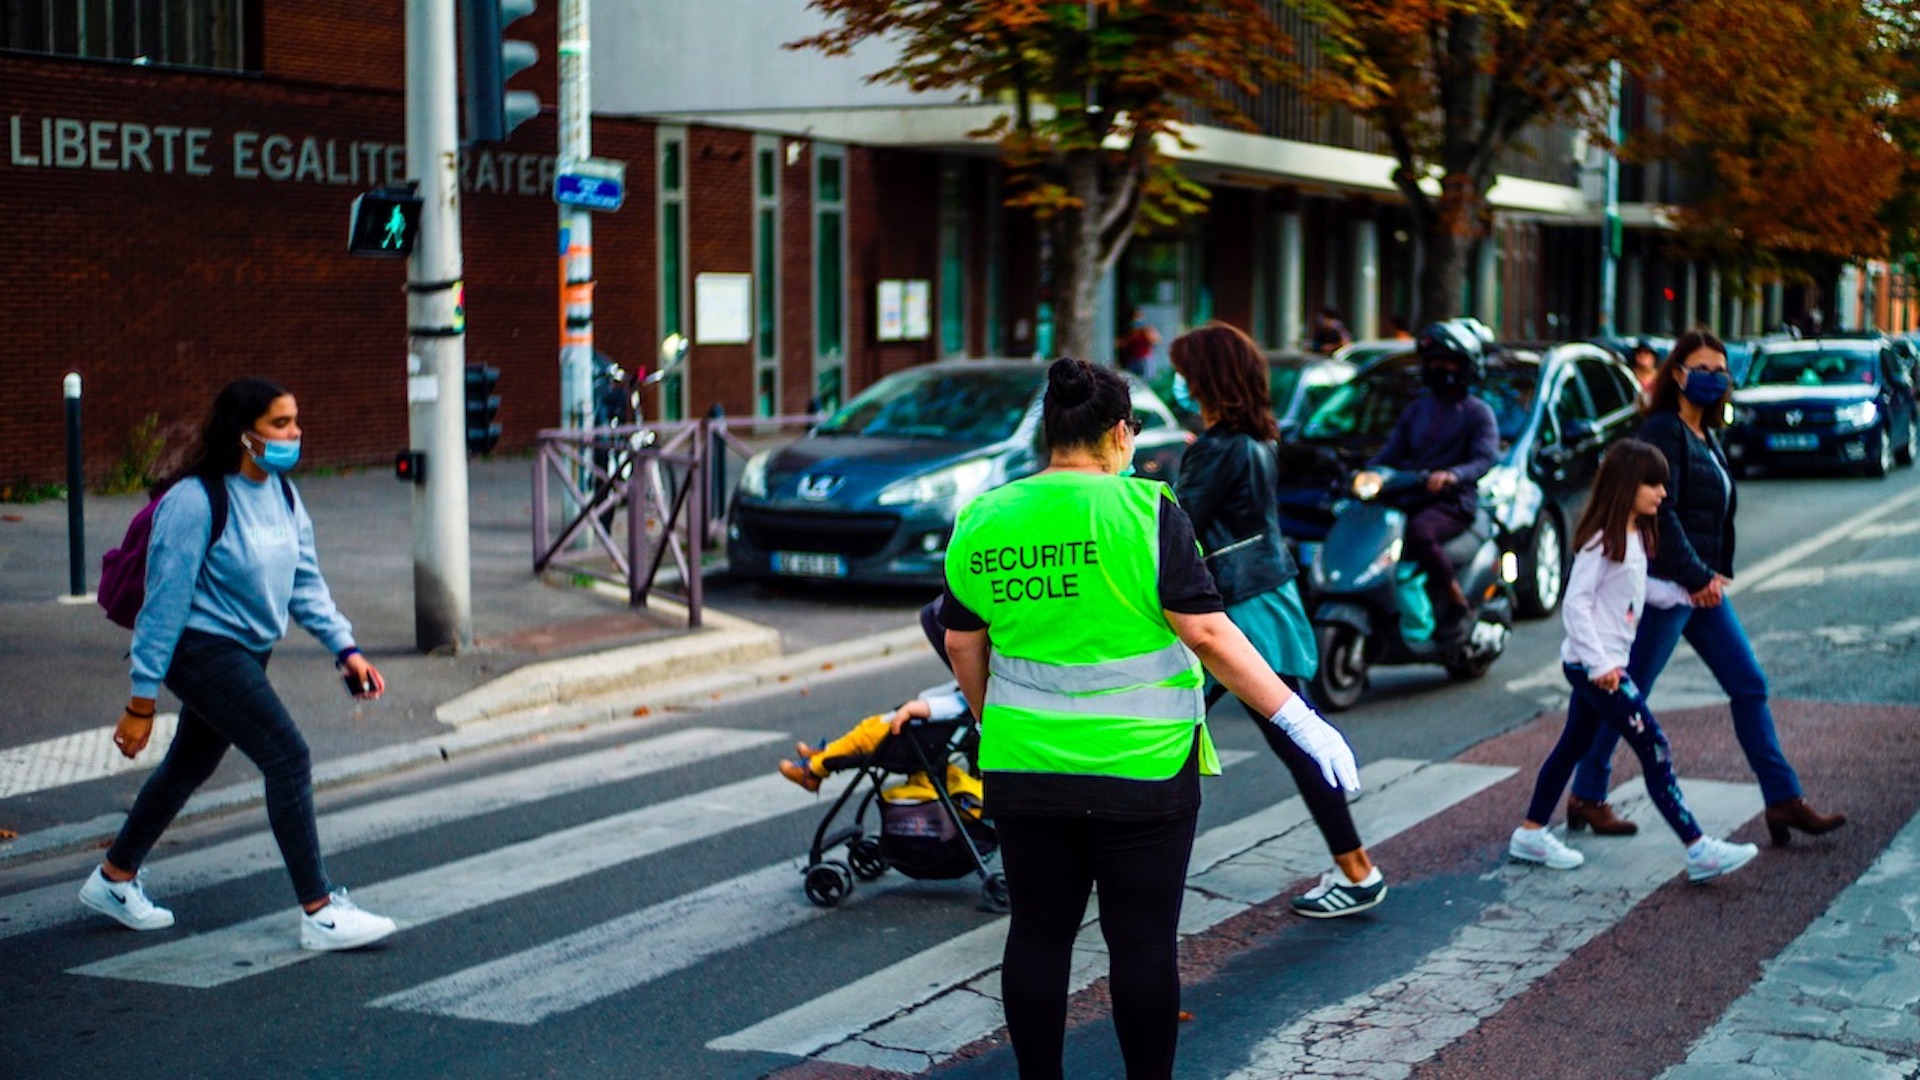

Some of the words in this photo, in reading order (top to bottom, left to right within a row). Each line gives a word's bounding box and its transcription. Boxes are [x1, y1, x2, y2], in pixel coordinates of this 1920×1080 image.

[9, 114, 213, 176] LIBERTE
[232, 130, 406, 188] EGALITE
[458, 147, 557, 198] RATER
[969, 540, 1099, 575] SECURITE
[991, 573, 1080, 604] ECOLE
